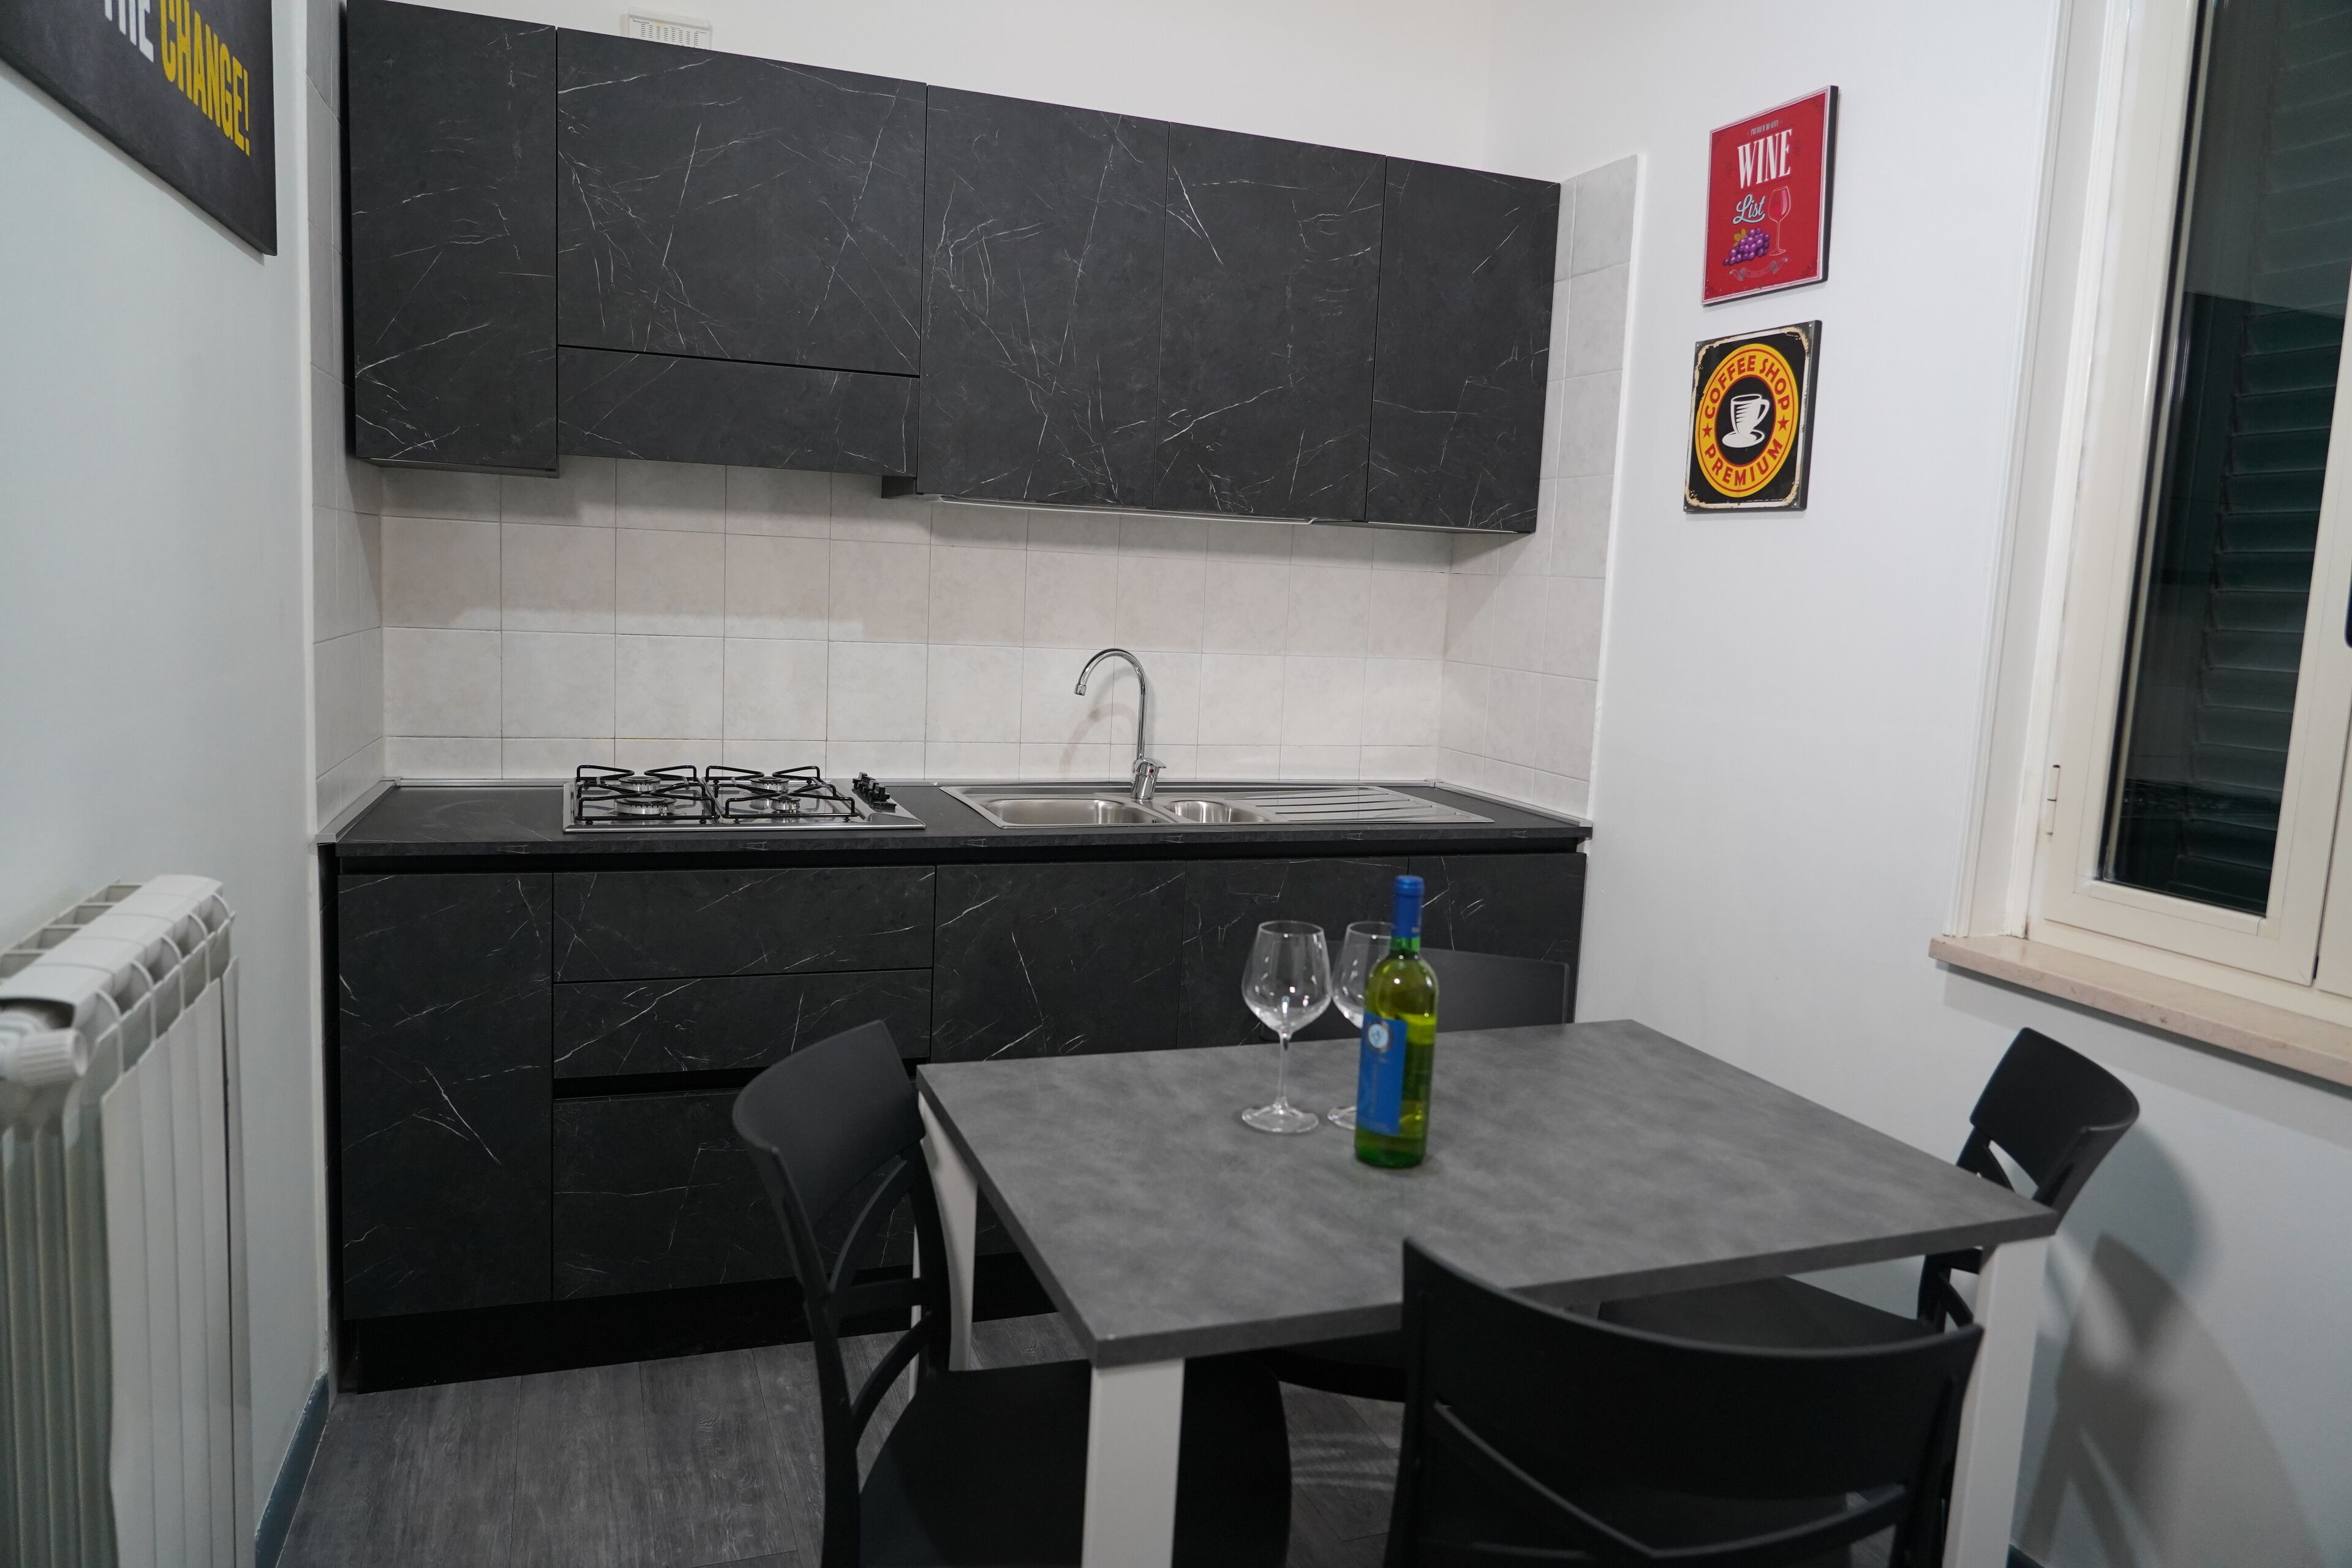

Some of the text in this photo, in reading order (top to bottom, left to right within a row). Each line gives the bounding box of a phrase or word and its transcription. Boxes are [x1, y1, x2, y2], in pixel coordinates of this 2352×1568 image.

[160, 0, 250, 156] CHANGE!
[1738, 129, 1792, 189] WINE
[1733, 194, 1766, 225] List
[1705, 355, 1790, 419] COFFEE SHOP
[1705, 438, 1783, 486] PREMIUM
